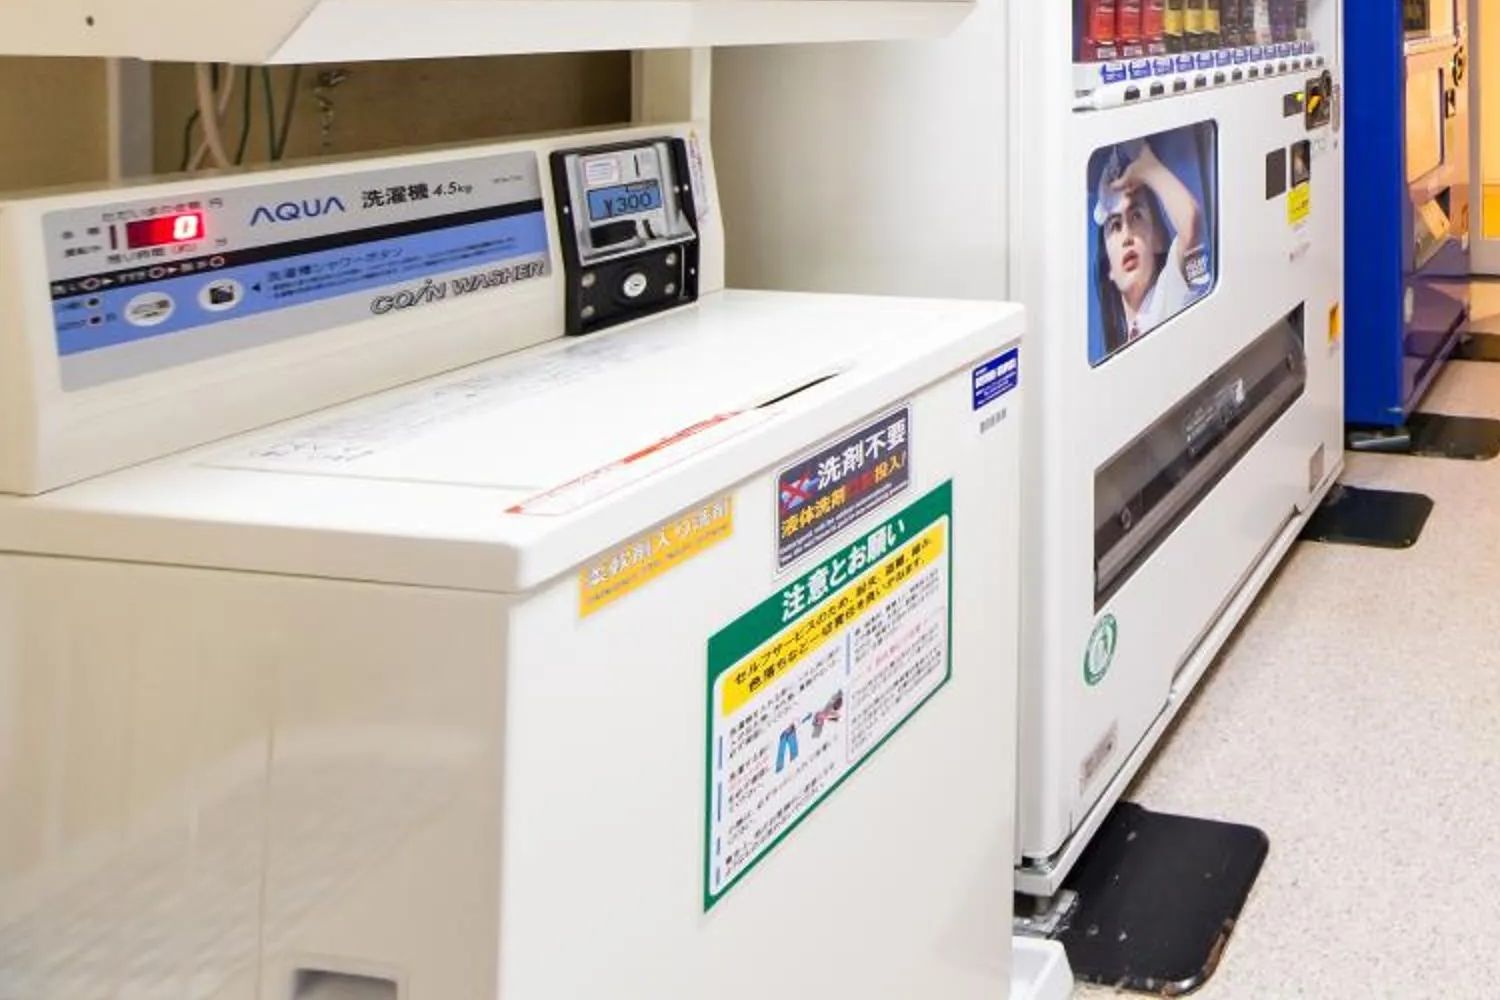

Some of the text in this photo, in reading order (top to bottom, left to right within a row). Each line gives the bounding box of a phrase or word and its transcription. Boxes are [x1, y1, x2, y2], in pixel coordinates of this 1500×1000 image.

[250, 196, 345, 227] AQUA
[361, 181, 473, 209] 洗濯機 4.5kg
[174, 214, 198, 240] 0
[370, 278, 447, 316] COIN
[451, 261, 546, 297] WASHER
[817, 417, 906, 490] 洗剤不要
[781, 519, 906, 623] 注意とお願い
